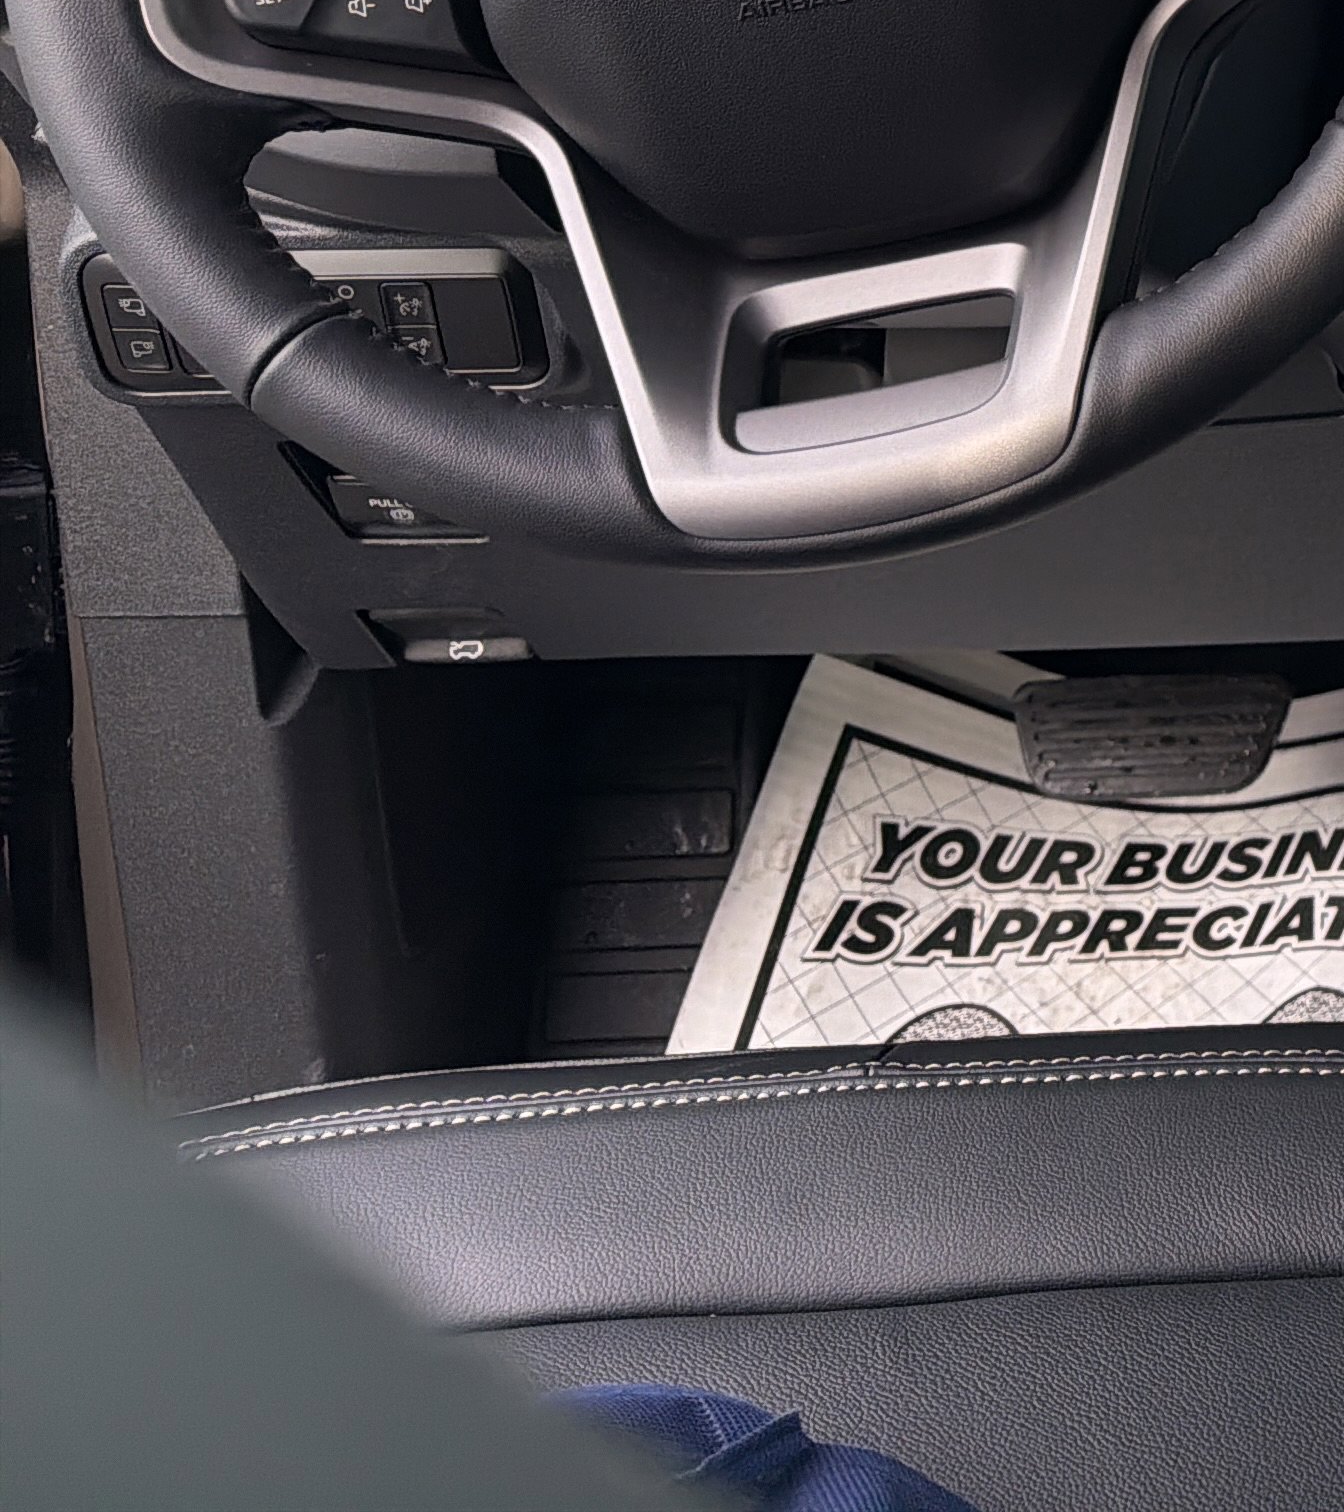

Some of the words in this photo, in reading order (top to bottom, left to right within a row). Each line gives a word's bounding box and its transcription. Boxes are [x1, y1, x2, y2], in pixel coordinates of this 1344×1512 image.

[368, 498, 404, 508] PULL
[870, 822, 1102, 887] YOUR
[813, 900, 905, 955] IS
